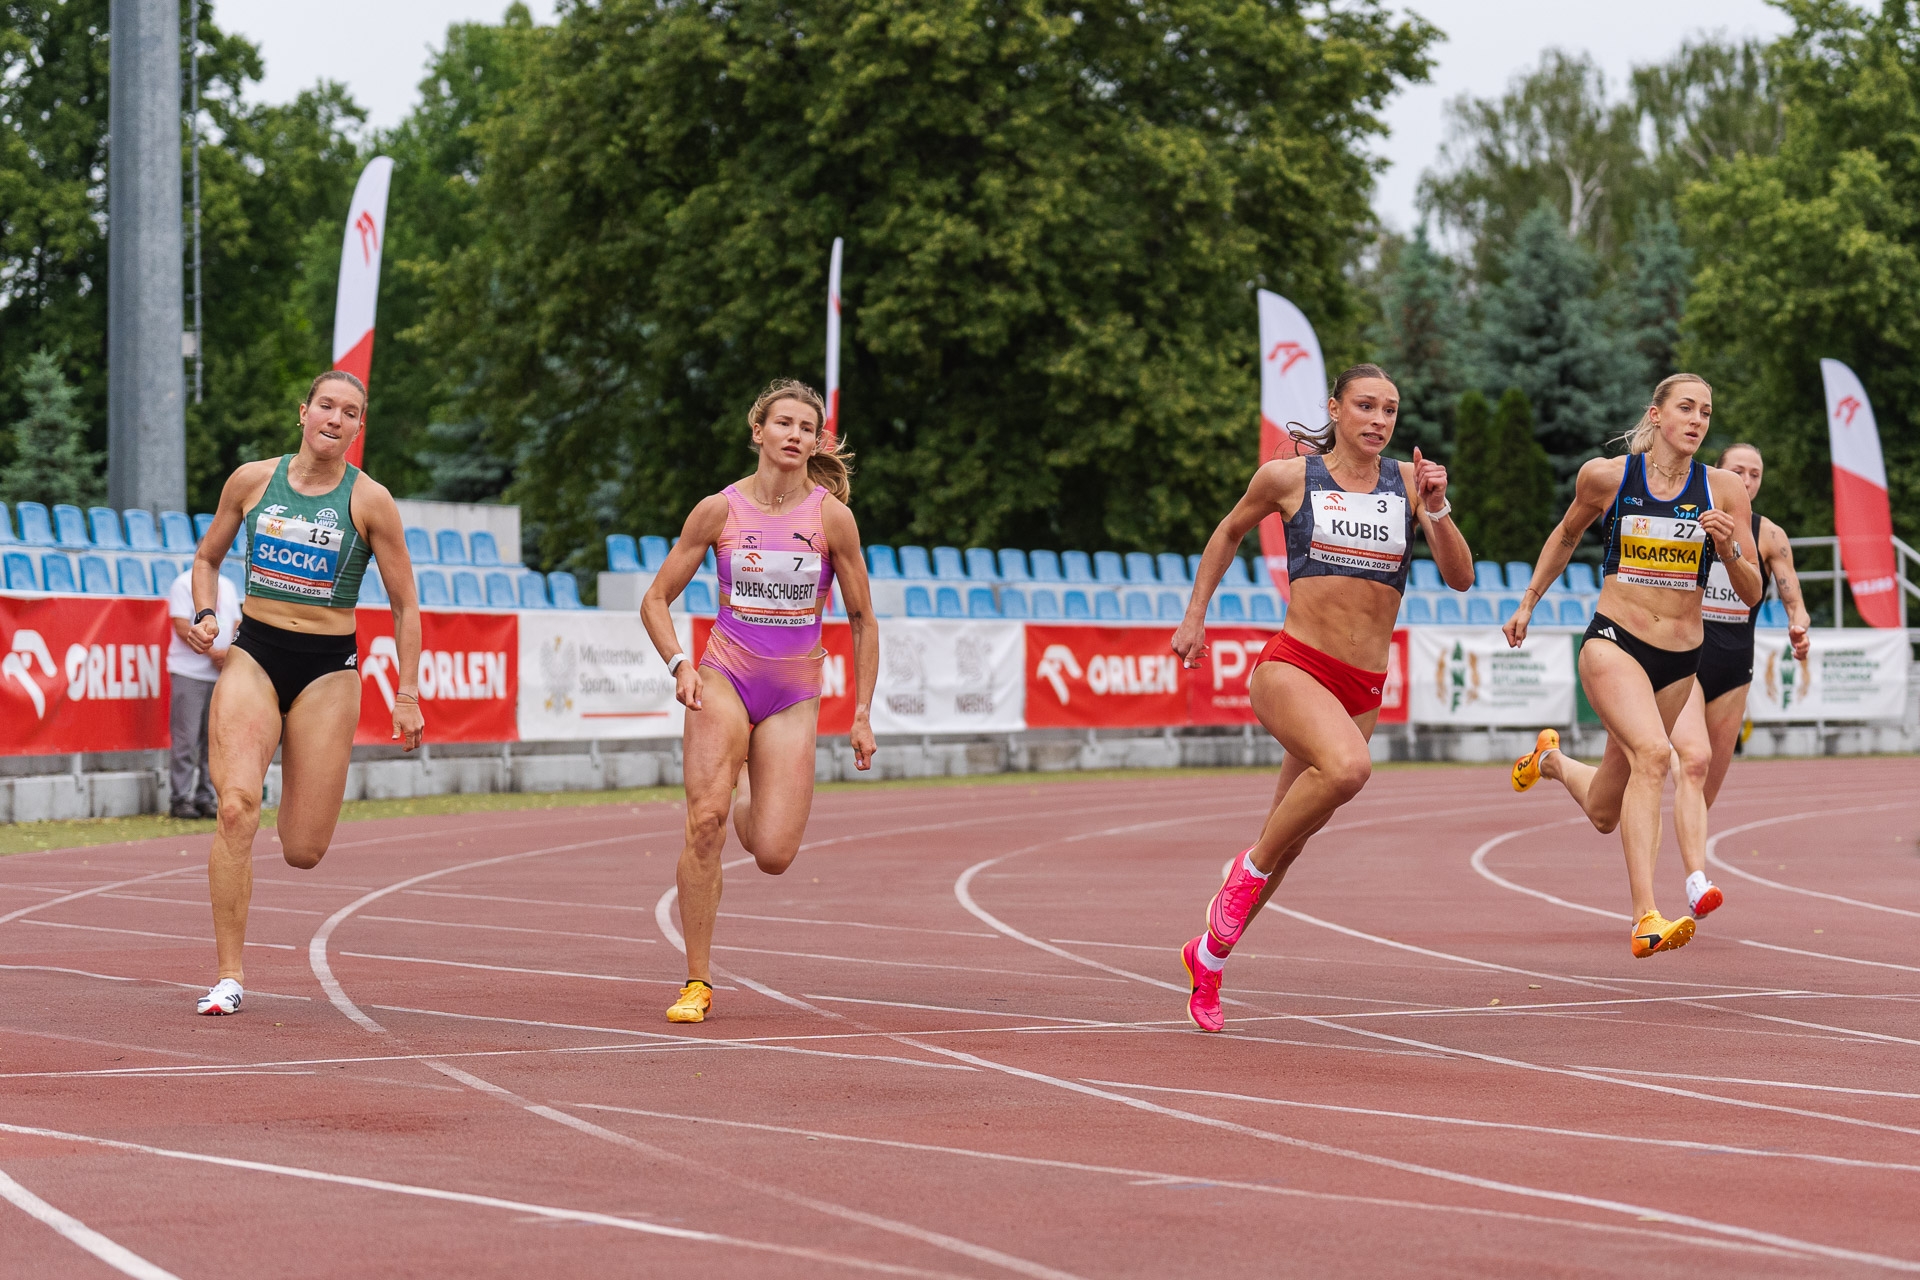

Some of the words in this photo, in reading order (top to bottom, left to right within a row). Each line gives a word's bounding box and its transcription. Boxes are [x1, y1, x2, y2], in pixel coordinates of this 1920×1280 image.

[264, 504, 288, 516] 4F
[1377, 499, 1388, 514] 3
[1624, 496, 1643, 507] esa
[1673, 506, 1699, 520] Sopot
[308, 528, 331, 545] 15
[1332, 519, 1389, 542] KUBIS
[1673, 523, 1696, 539] 27
[258, 543, 328, 573] SŁOCKA
[1321, 553, 1370, 567] WARSZAWA
[1371, 561, 1390, 570] 2025
[1624, 544, 1697, 564] LIGARSKA
[793, 557, 803, 571] 7
[259, 577, 301, 593] WARSZAWA
[302, 588, 321, 596] 2025
[735, 580, 815, 600] SUŁEK-SCHUBERT
[1627, 577, 1672, 587] WARSZAWA
[1704, 586, 1741, 602] ELSK
[741, 614, 788, 625] WARSZAWA
[65, 643, 161, 702] ORLEN
[418, 649, 507, 700] ORLEN
[1087, 655, 1178, 695] ORLEN
